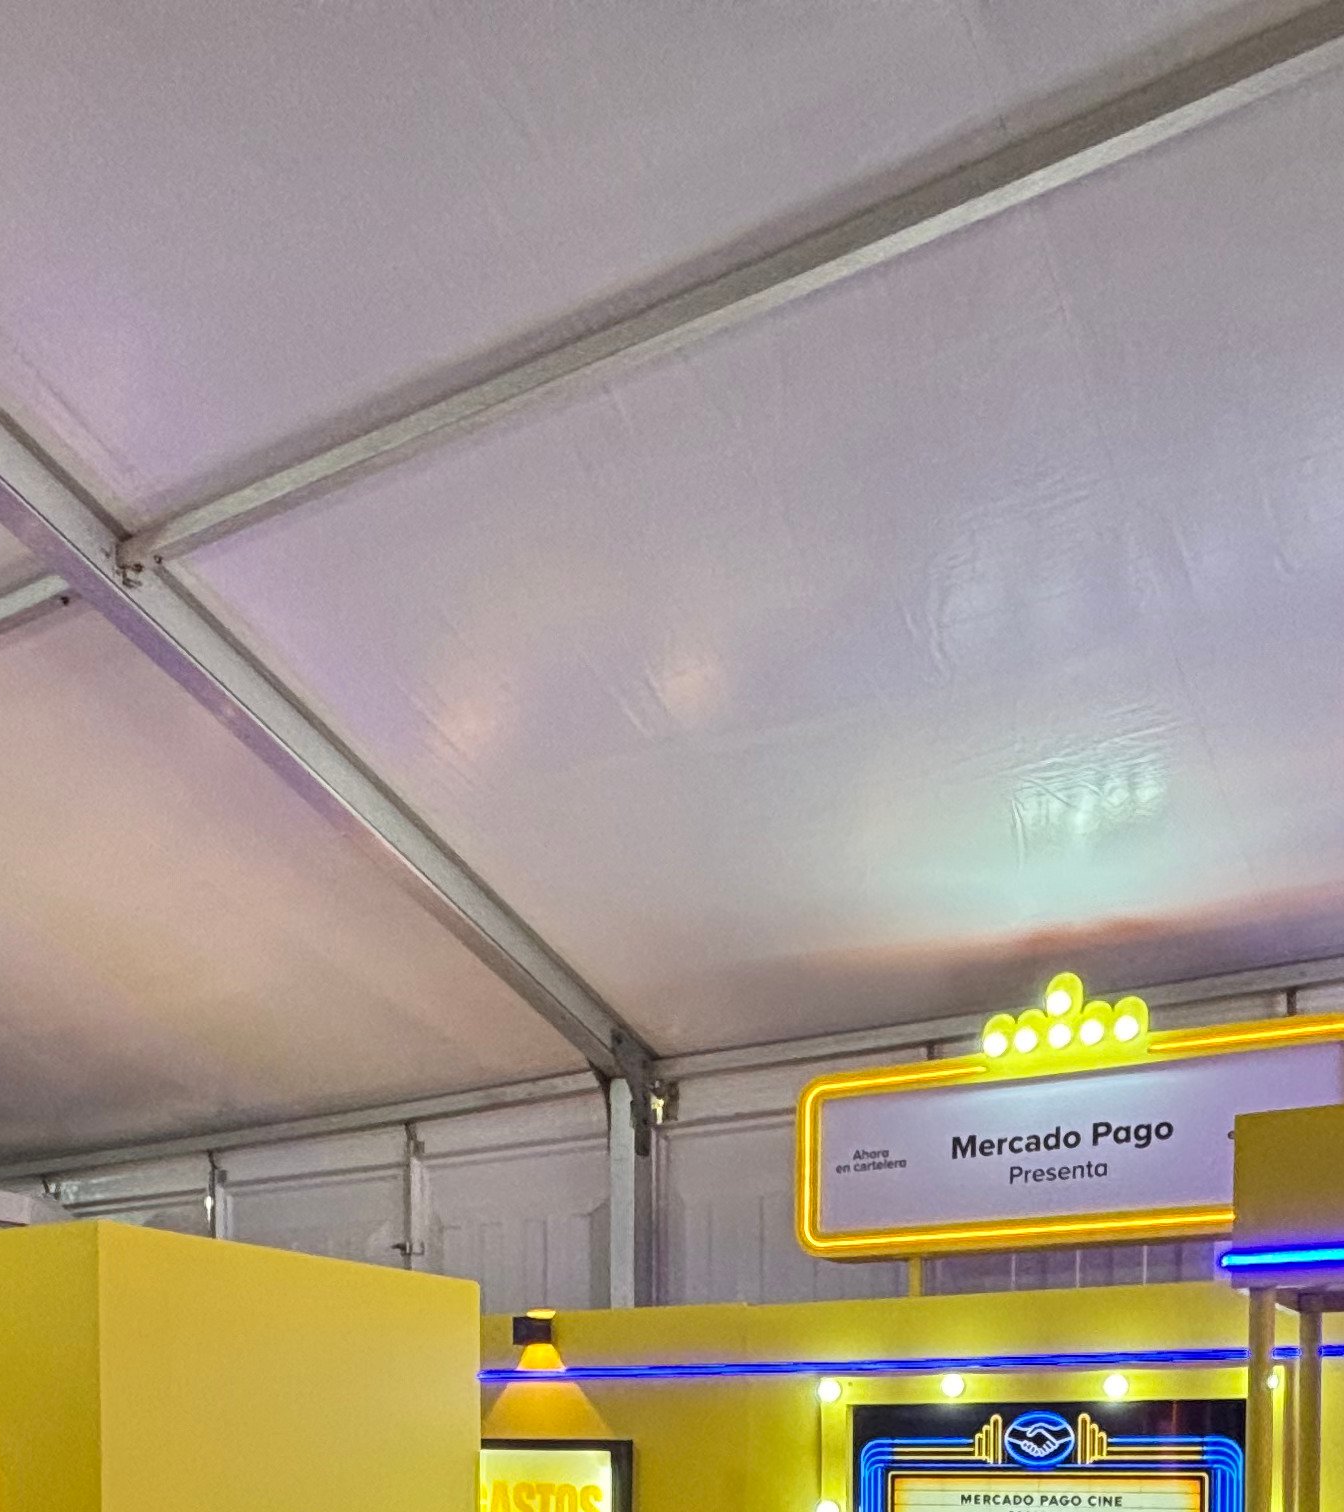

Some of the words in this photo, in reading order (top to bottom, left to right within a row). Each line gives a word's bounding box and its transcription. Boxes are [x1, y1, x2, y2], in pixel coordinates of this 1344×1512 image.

[951, 1126, 1081, 1159] Mercado
[1092, 1121, 1174, 1148] Pago
[852, 1149, 889, 1160] Ahora
[836, 1163, 850, 1173] en
[853, 1159, 907, 1172] cartelera
[1009, 1161, 1108, 1184] Presenta
[960, 1494, 1034, 1506] MERCADO
[1040, 1495, 1082, 1507] PAGO
[1088, 1496, 1123, 1507] CINE
